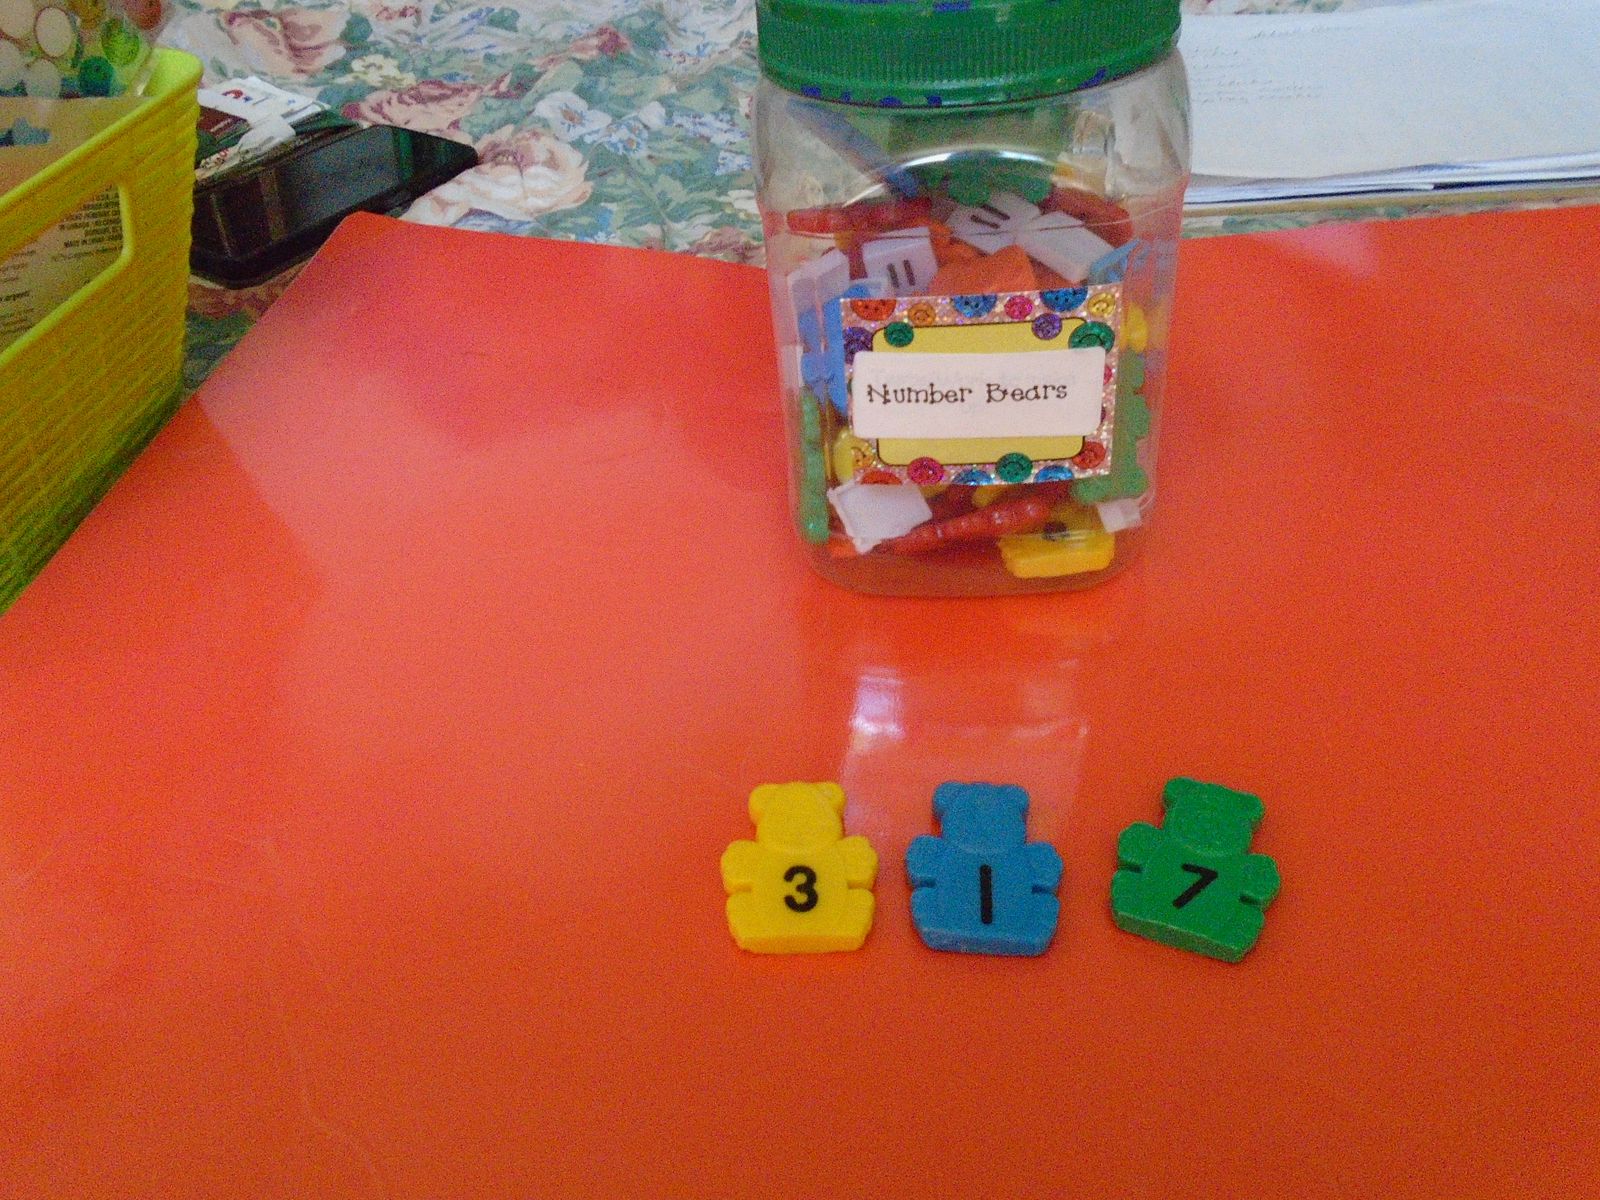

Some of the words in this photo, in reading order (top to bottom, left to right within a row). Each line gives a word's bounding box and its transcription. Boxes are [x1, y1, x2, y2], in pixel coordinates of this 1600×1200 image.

[866, 381, 974, 406] Number
[985, 382, 1068, 404] Bears
[784, 865, 818, 913] 3
[1172, 864, 1218, 909] 7
